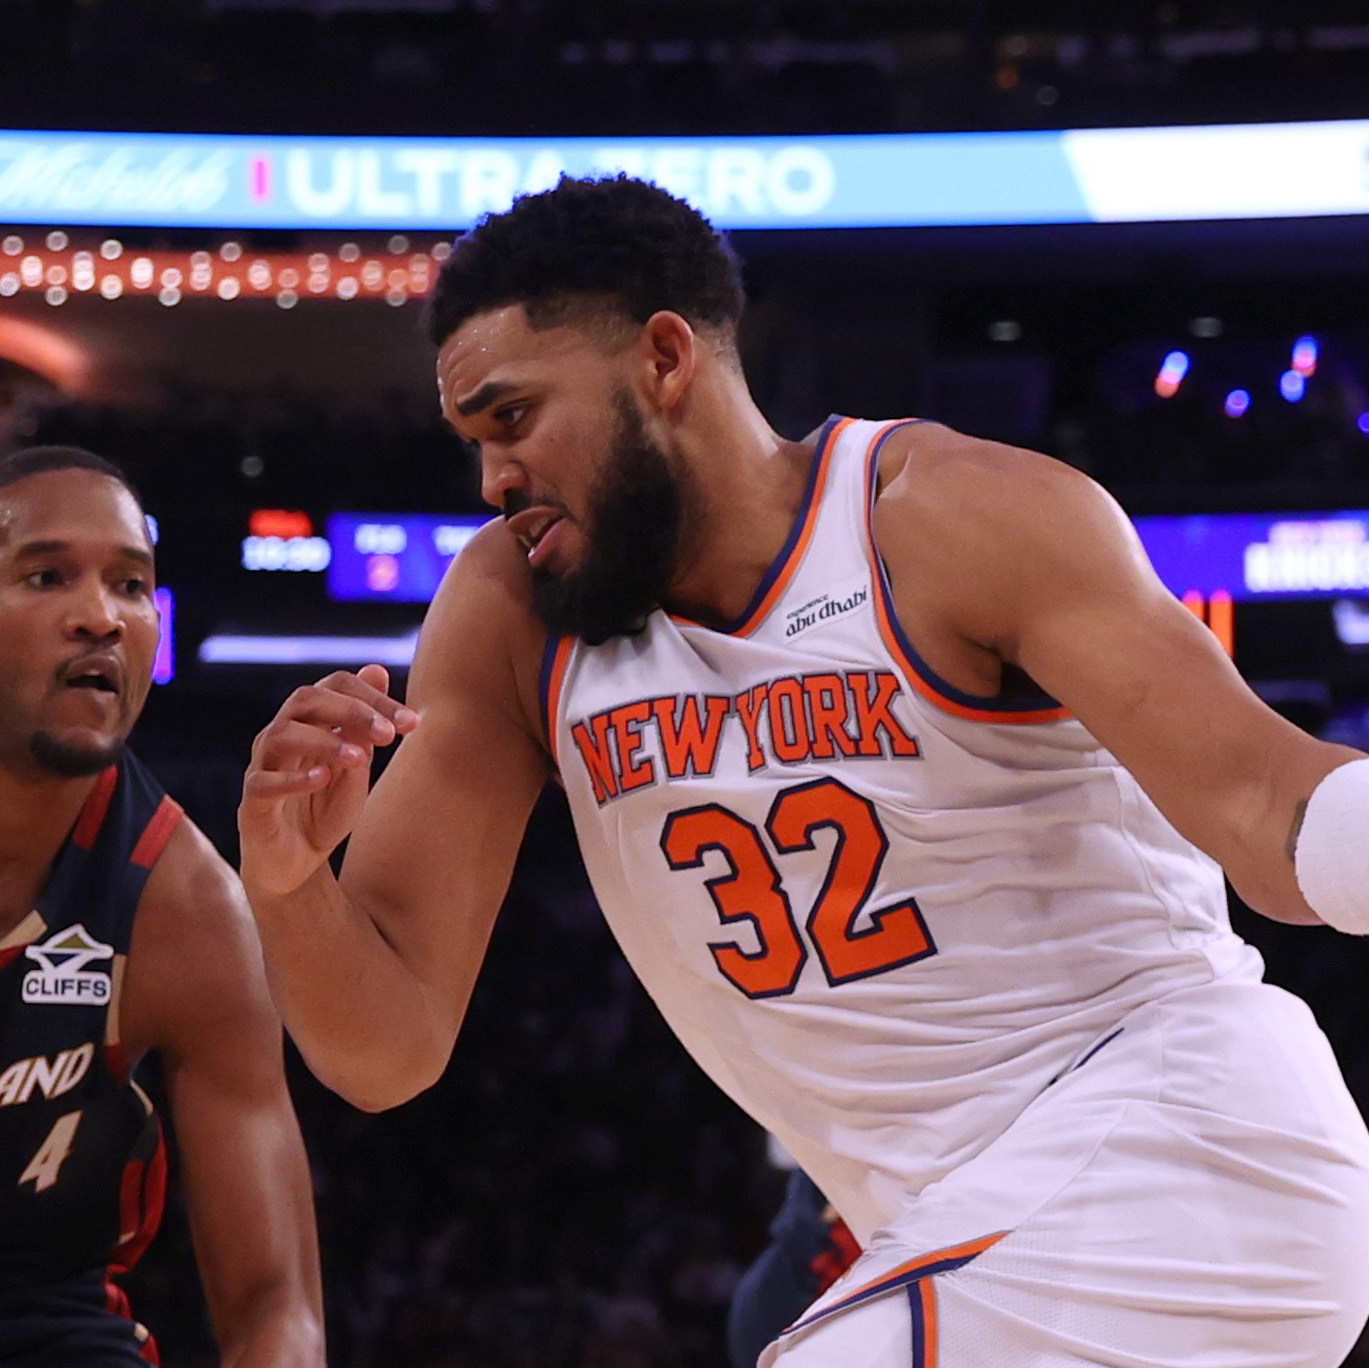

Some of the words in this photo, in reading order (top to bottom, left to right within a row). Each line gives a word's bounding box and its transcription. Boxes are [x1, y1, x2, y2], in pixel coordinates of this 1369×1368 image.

[786, 612, 817, 637] abu
[819, 585, 868, 620] dhabi
[571, 692, 734, 809] NEW
[733, 669, 924, 778] YORK
[659, 775, 938, 1001] 32
[25, 977, 109, 997] CLIFFS
[17, 1108, 84, 1194] 4
